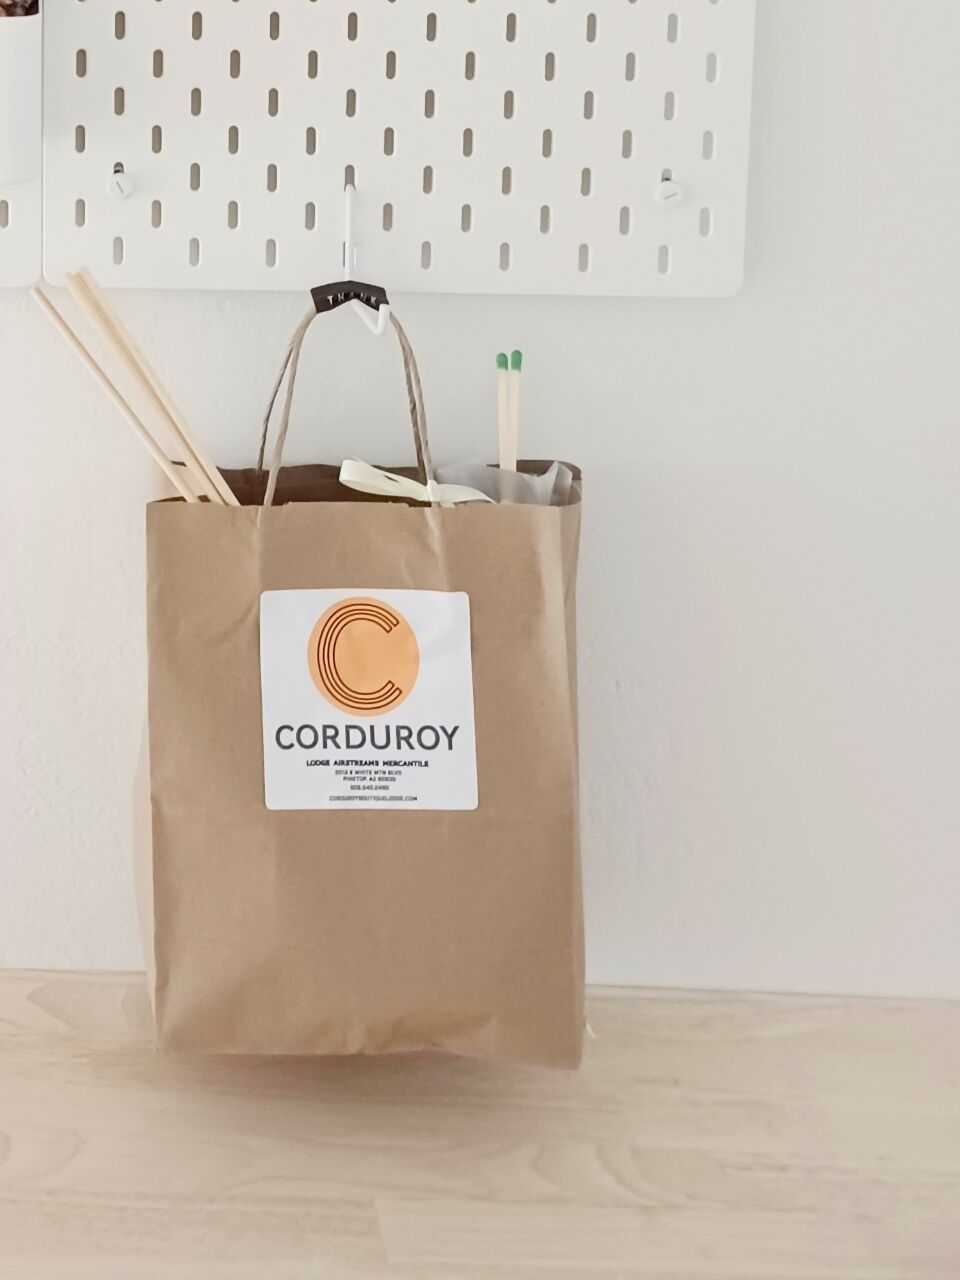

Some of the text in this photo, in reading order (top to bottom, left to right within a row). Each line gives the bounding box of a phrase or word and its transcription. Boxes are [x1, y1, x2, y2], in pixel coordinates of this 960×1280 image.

[327, 291, 377, 307] THANK
[275, 724, 460, 751] CORDUROY
[306, 759, 330, 767] LODGE
[333, 759, 380, 767] AIRSTREAMS
